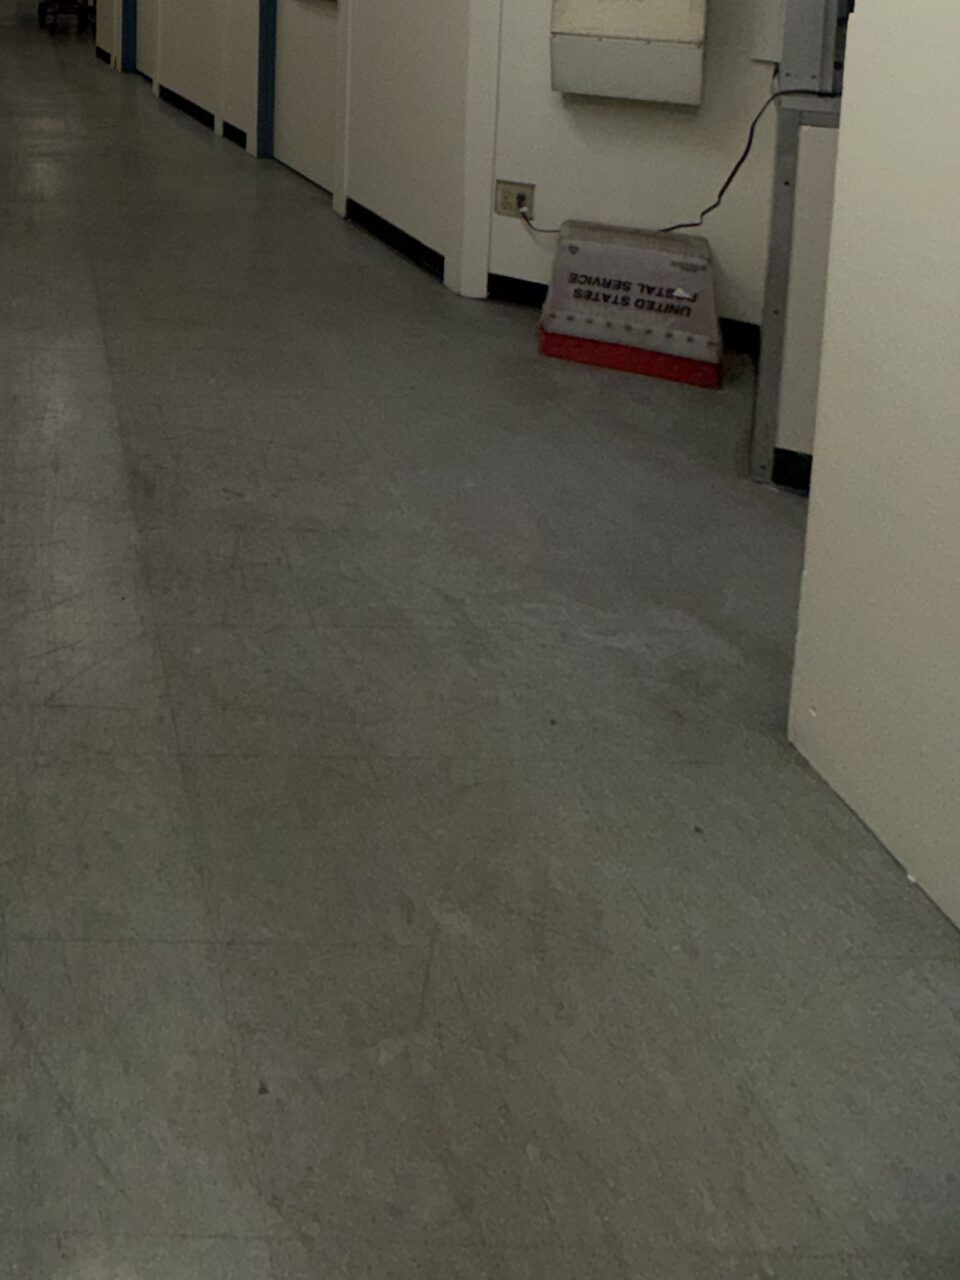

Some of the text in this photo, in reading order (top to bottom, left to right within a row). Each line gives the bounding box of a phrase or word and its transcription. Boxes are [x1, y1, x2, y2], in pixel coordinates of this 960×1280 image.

[568, 272, 698, 303] PSTAL SERVICE
[572, 288, 692, 318] UNITED STATES
